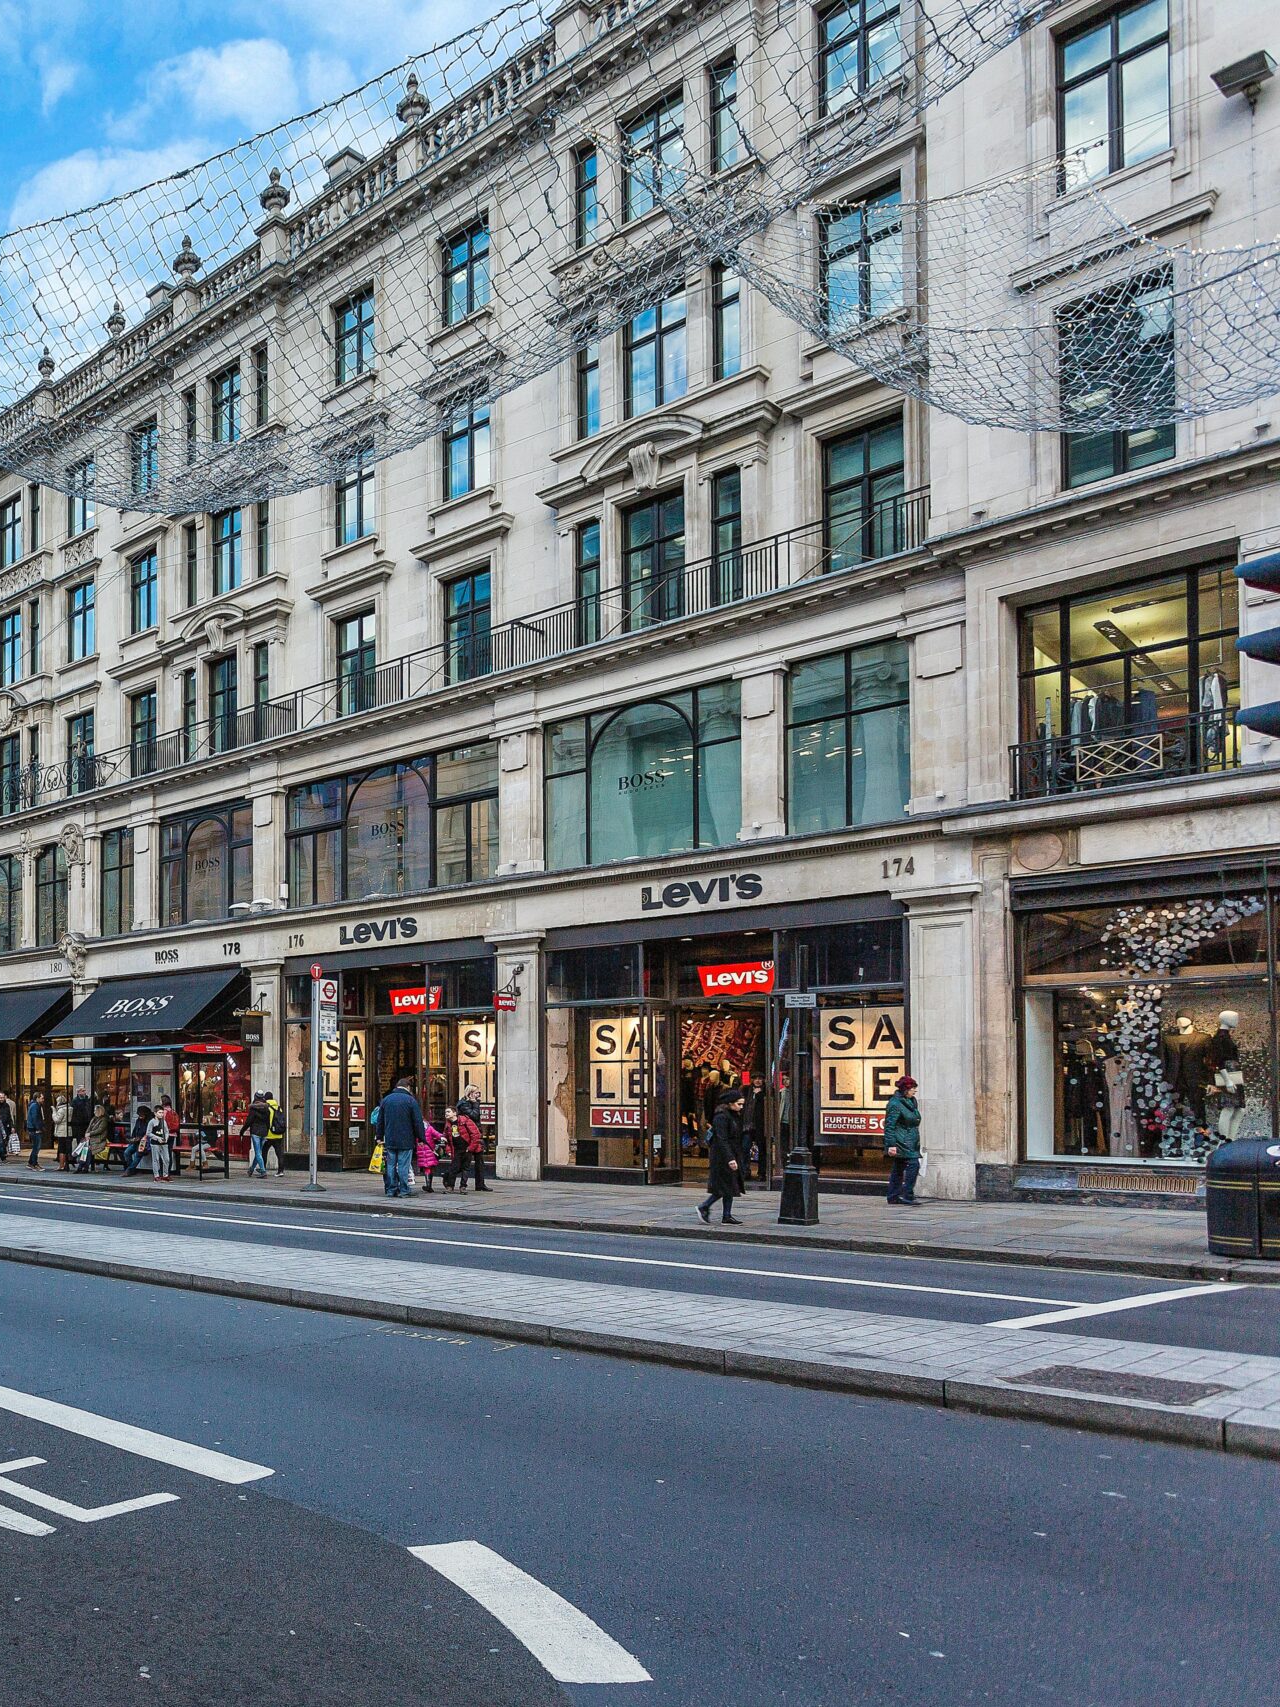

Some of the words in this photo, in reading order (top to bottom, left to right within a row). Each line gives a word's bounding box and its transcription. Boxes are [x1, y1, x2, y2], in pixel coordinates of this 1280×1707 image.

[618, 769, 665, 791] BOSS
[371, 820, 405, 837] BOSS
[195, 857, 220, 871] BOSS
[881, 856, 915, 879] 174
[288, 934, 305, 949] 176
[154, 949, 179, 962] BOSS
[222, 942, 241, 956] 178
[50, 962, 63, 974] 180
[314, 966, 321, 977] T
[104, 995, 174, 1015] BOSS
[827, 1014, 904, 1051] SA
[325, 1072, 363, 1097] LE
[829, 1066, 899, 1101] LE
[329, 1107, 359, 1118] SAE
[602, 1110, 641, 1124] SALE
[824, 1116, 866, 1124] FURTHER
